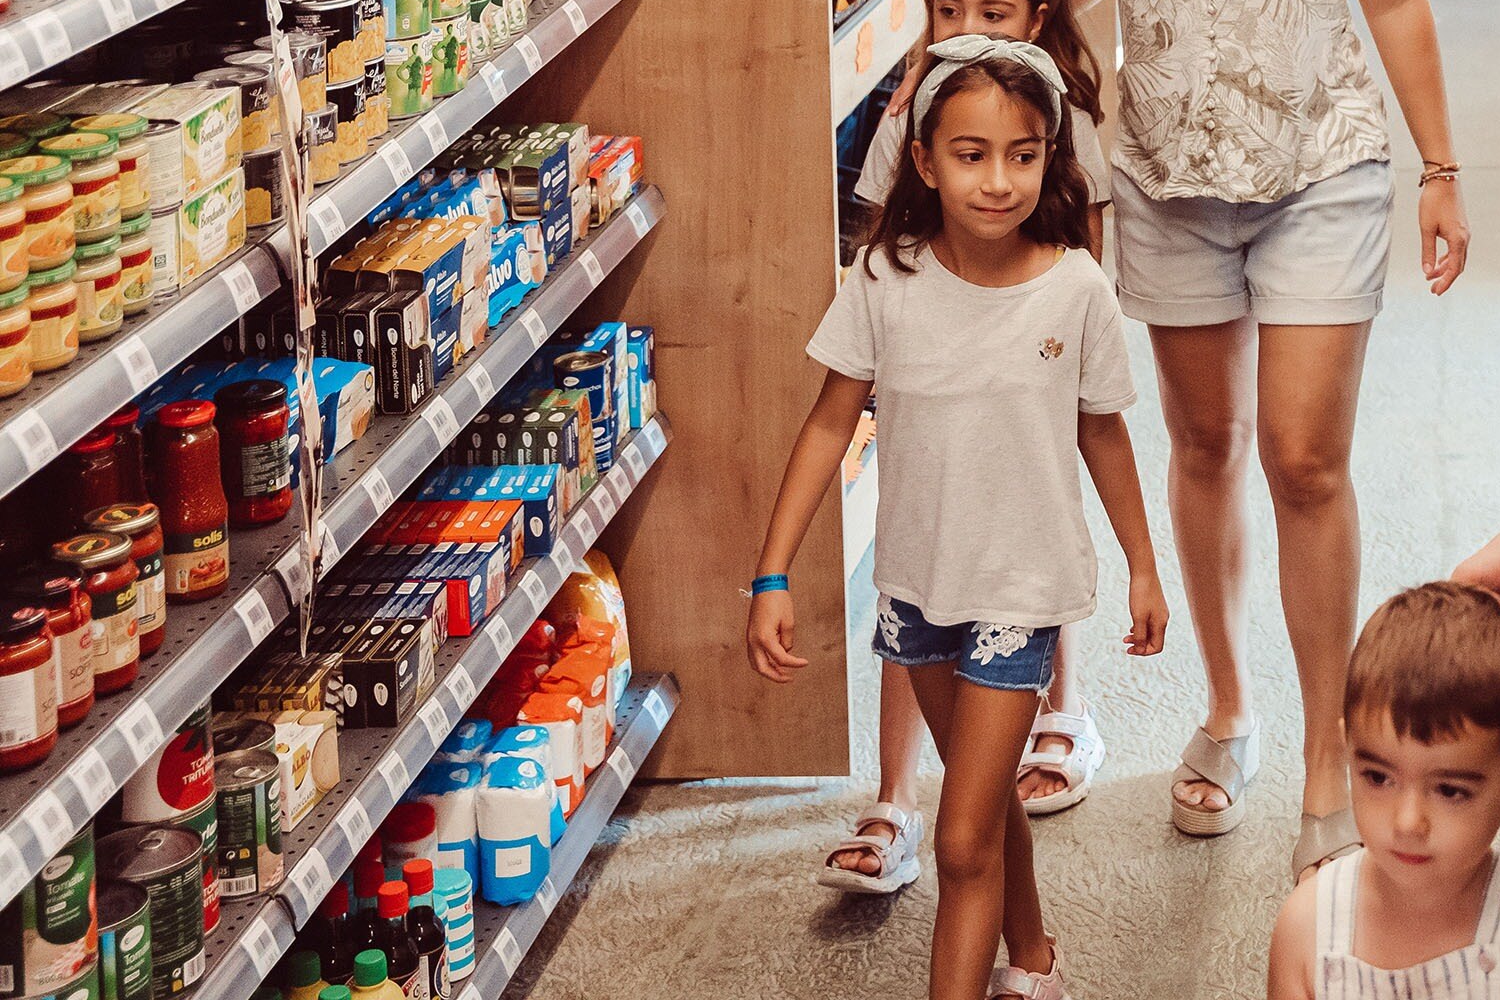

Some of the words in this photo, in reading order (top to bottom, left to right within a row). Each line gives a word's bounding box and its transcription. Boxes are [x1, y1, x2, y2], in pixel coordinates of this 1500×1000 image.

[390, 347, 398, 368] Bonito
[391, 368, 399, 380] del
[291, 750, 312, 776] ALBO
